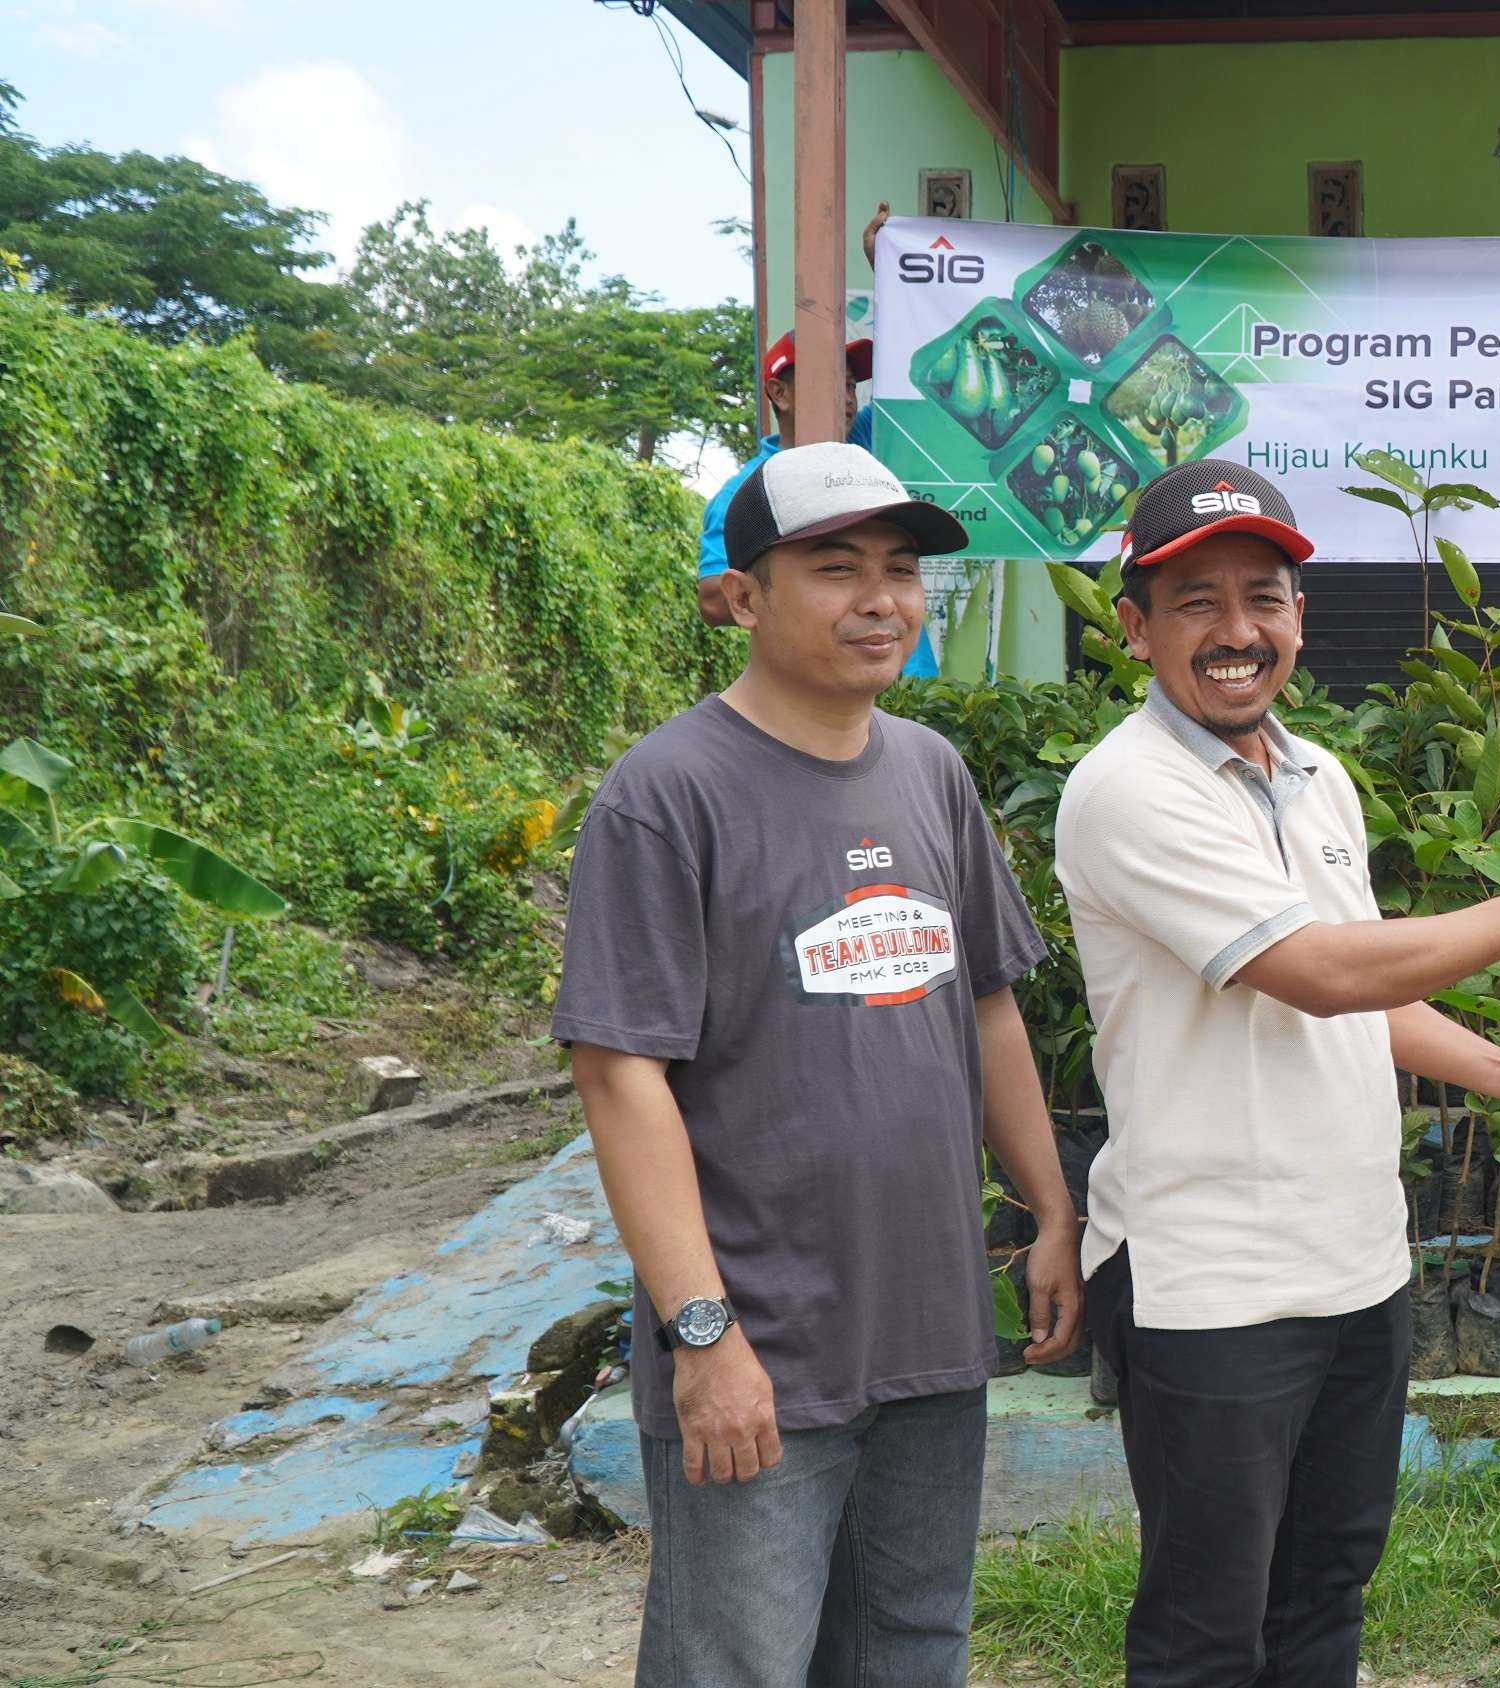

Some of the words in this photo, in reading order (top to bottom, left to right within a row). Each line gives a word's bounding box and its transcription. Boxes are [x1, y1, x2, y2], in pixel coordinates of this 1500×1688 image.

[898, 253, 985, 284] SIG
[1253, 325, 1432, 366] Program
[1364, 379, 1433, 410] SIG
[1247, 441, 1329, 475] Hijau
[1191, 491, 1262, 515] SIG
[846, 846, 893, 871] SIG
[1321, 845, 1352, 867] SIG
[837, 910, 908, 932] MEETING
[912, 909, 924, 921] &
[803, 934, 871, 976] TEAM
[868, 925, 951, 960] BUILDING
[850, 966, 887, 985] FMK
